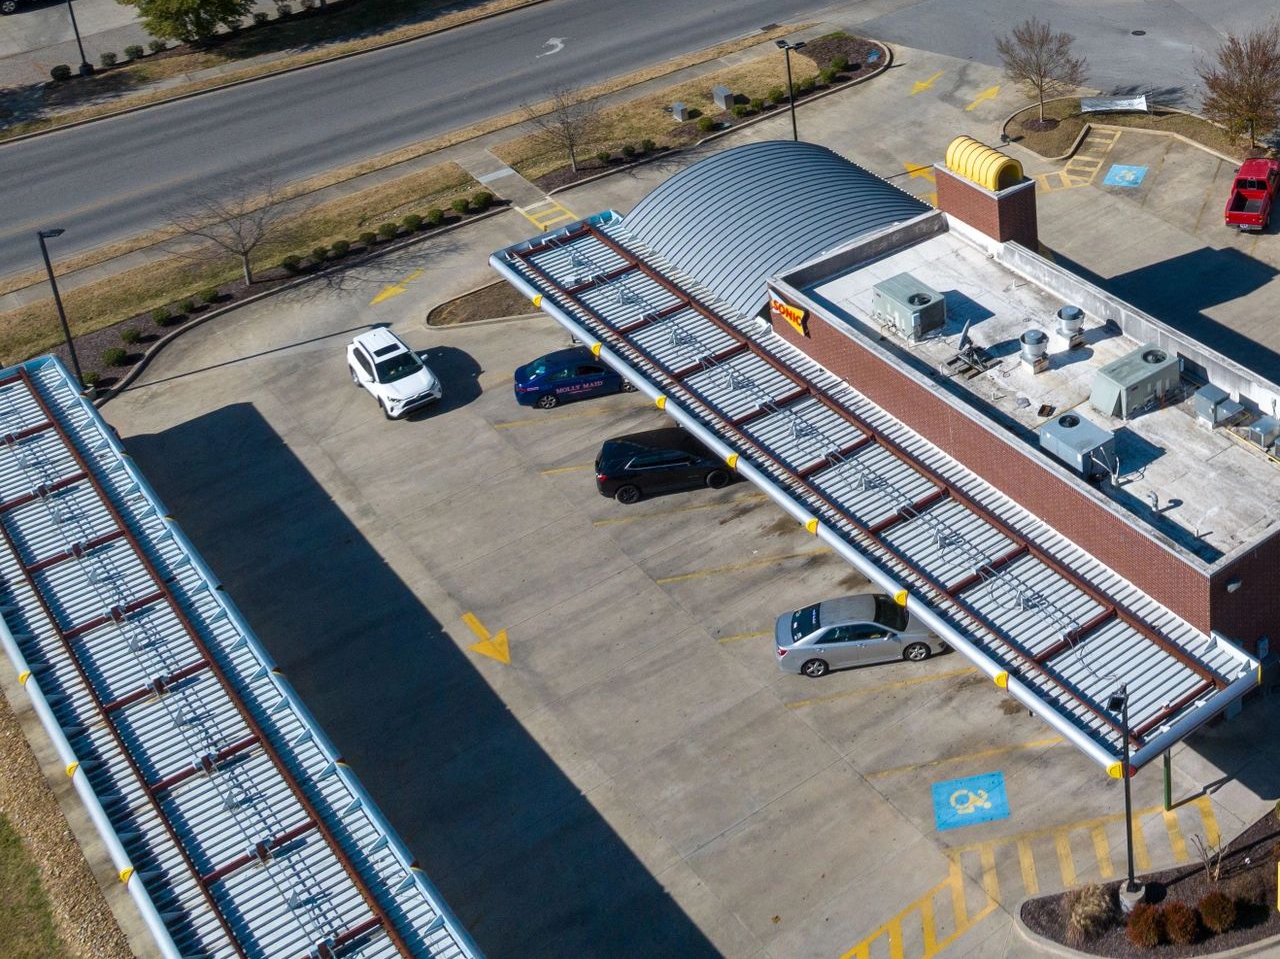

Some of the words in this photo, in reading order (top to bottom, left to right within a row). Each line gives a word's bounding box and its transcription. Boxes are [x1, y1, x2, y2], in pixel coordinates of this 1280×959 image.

[772, 300, 801, 326] SONIC
[556, 384, 580, 394] MOLLY
[583, 380, 603, 389] MAID
